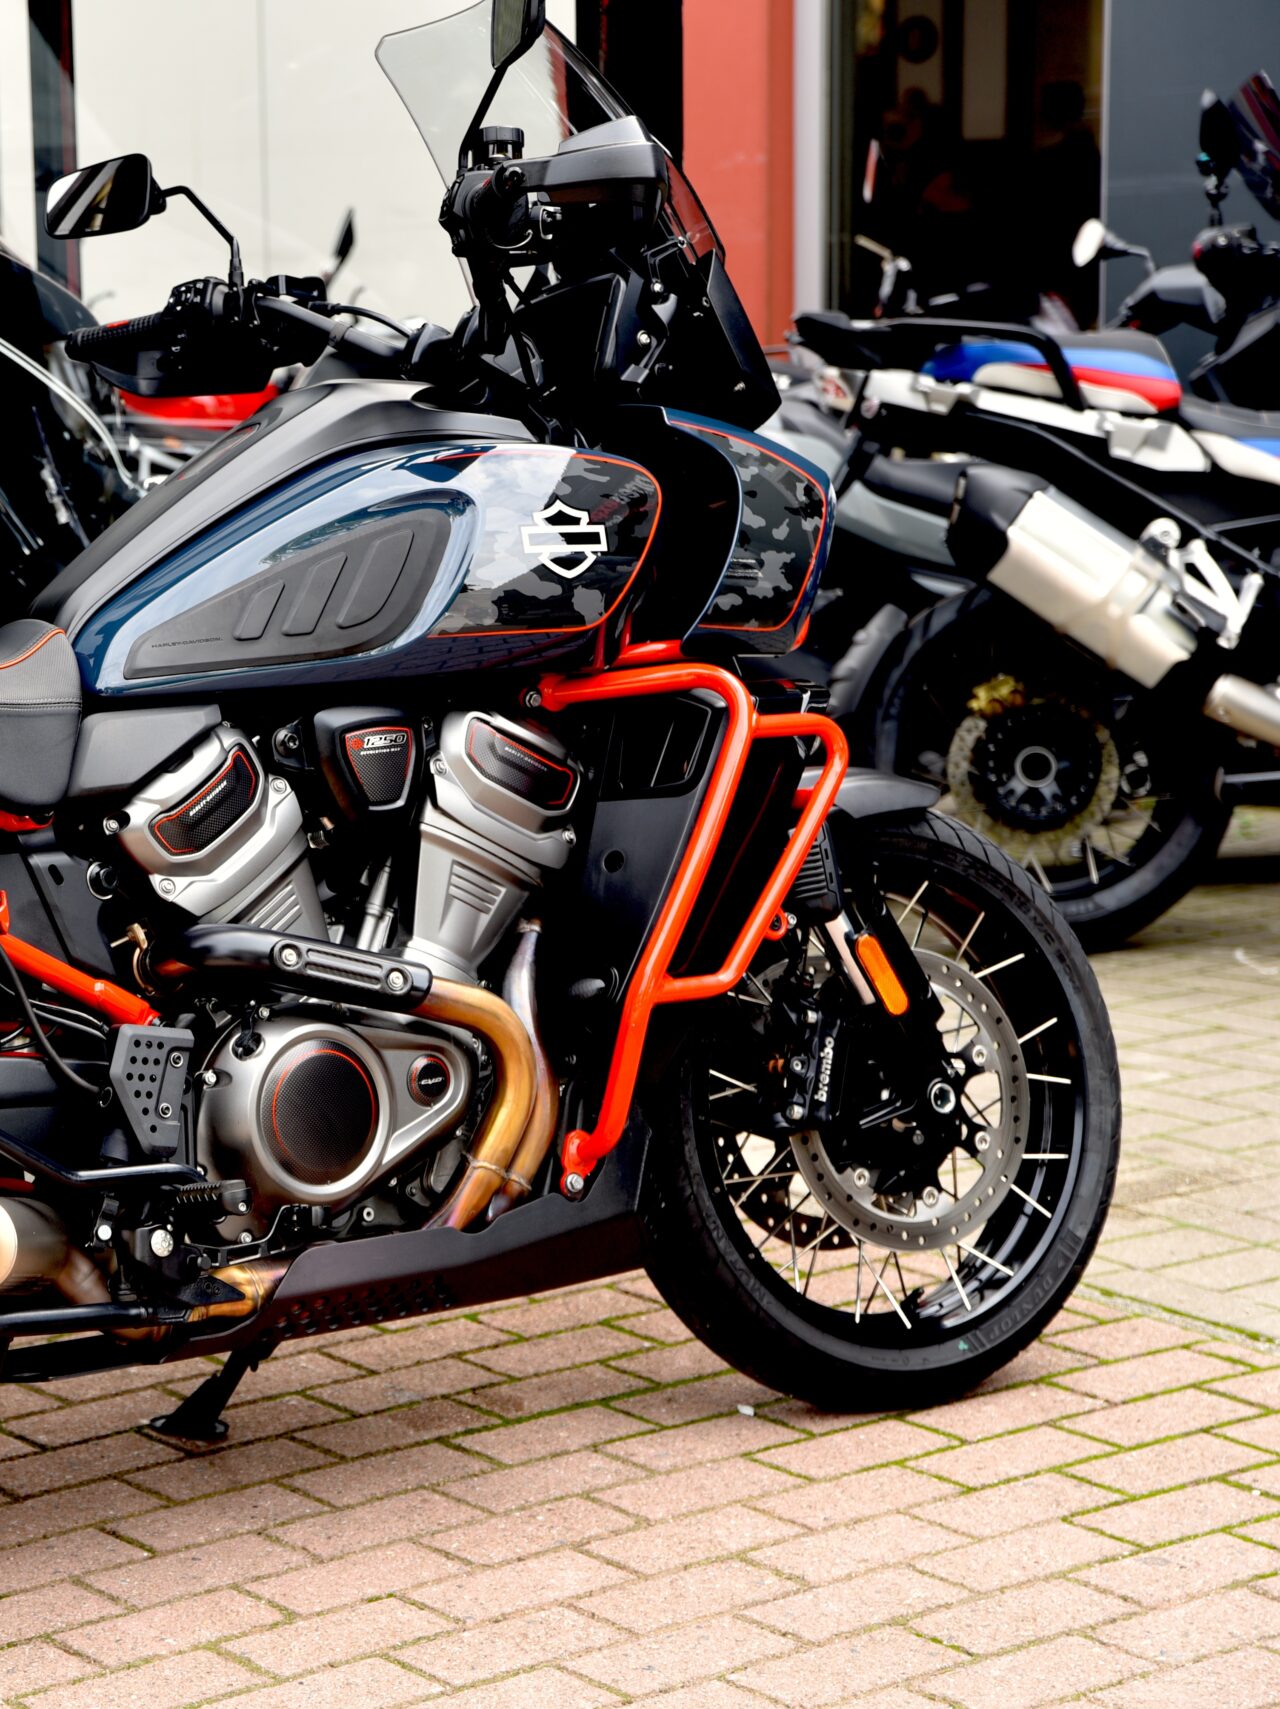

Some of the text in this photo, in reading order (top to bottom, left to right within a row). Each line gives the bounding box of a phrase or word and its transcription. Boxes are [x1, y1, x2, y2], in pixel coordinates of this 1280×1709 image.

[363, 733, 408, 748] 1250
[421, 1077, 443, 1085] CVO
[814, 1036, 835, 1103] brembo
[989, 1273, 1054, 1340] DUNLOP
